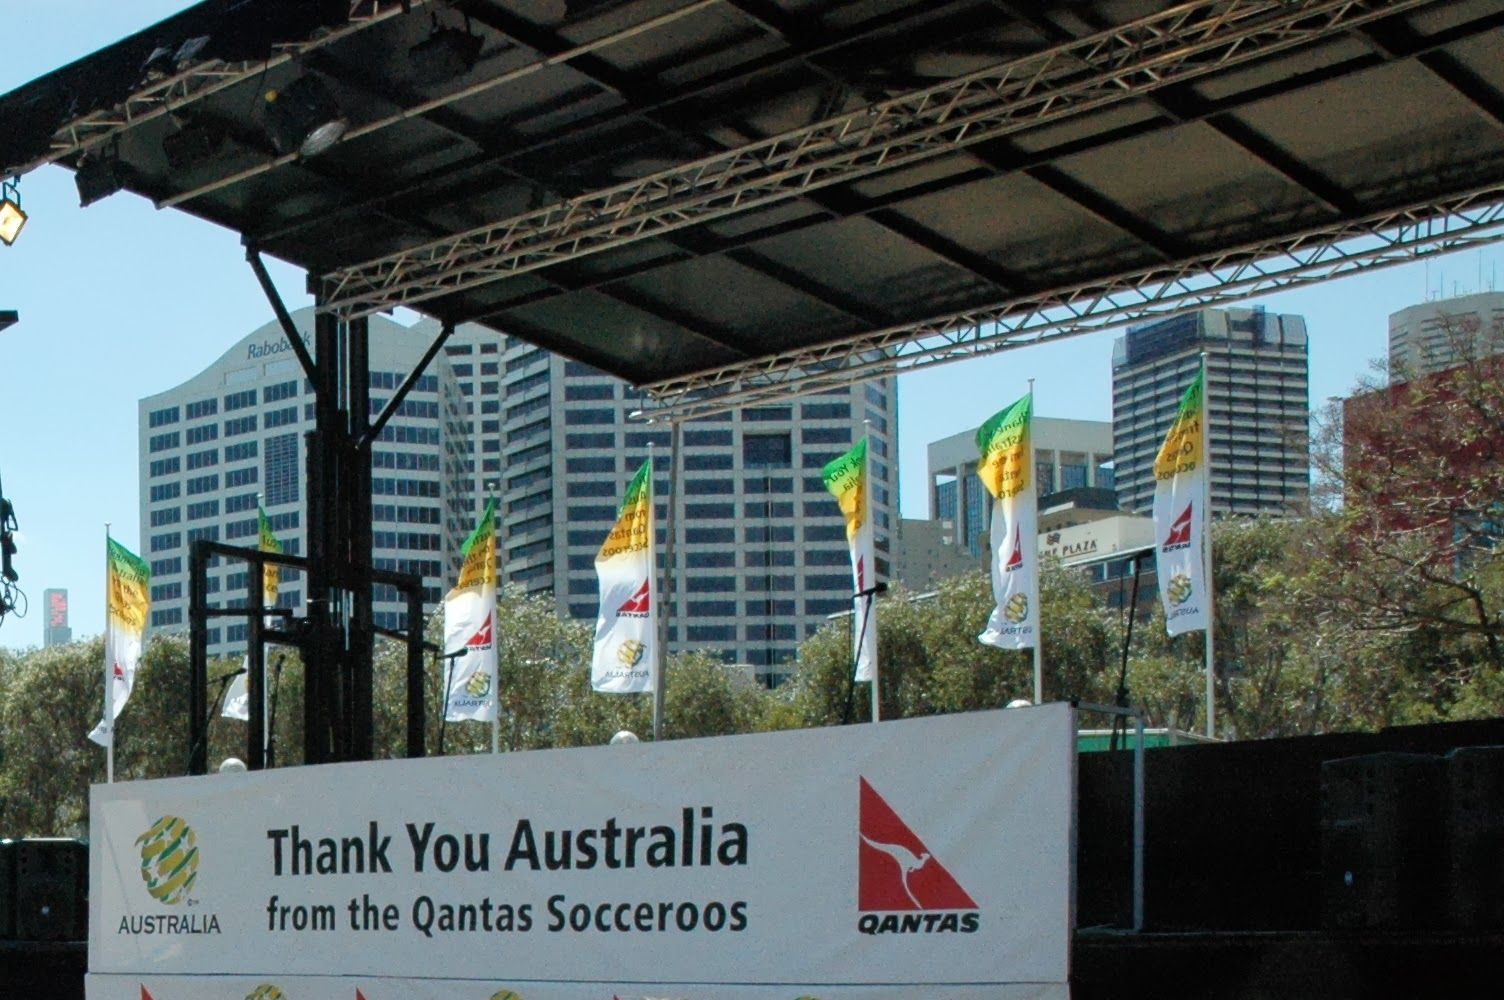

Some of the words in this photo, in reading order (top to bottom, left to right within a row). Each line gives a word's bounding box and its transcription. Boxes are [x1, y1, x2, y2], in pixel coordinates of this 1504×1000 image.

[247, 331, 311, 360] Rabobk
[267, 821, 393, 876] Thank
[405, 822, 490, 873] You
[503, 806, 749, 871] Australia
[118, 914, 222, 935] AUSTRALIA
[266, 895, 336, 932] from
[347, 894, 400, 932] the
[411, 895, 533, 937] Qantas
[547, 894, 748, 932] Socceroos
[858, 913, 980, 935] QANTAS
